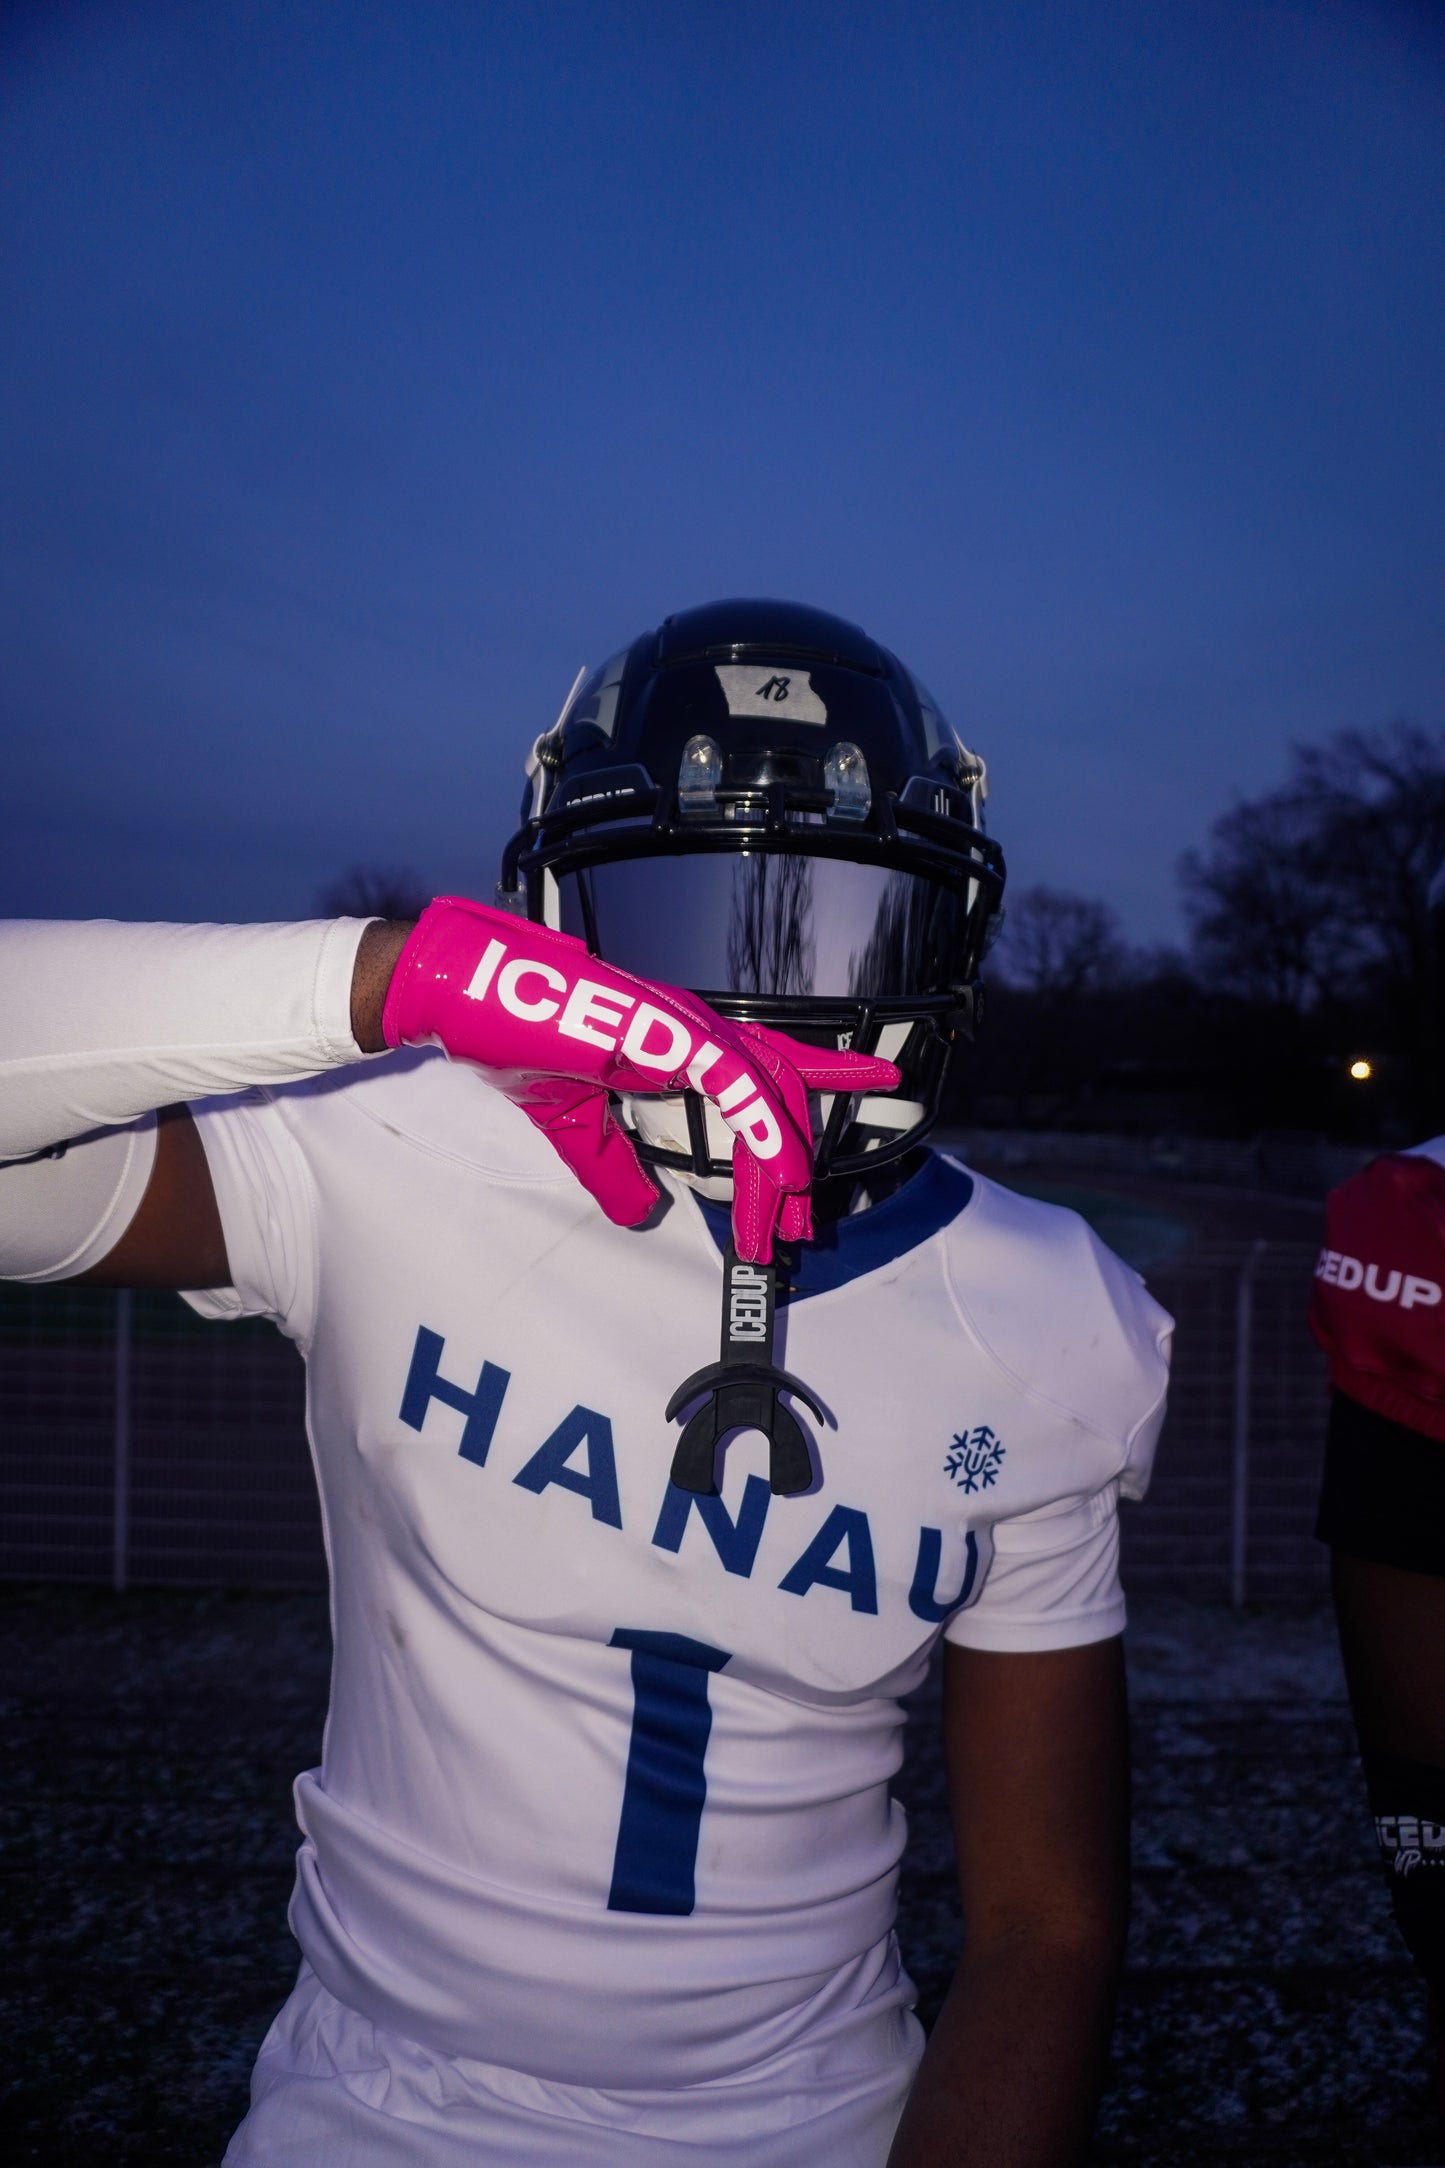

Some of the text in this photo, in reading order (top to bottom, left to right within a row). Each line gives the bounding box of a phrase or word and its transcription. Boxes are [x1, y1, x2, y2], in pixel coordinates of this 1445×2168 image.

[755, 675, 791, 702] 18
[463, 938, 783, 1160] ICEDUP
[729, 1265, 768, 1342] ICEDUP
[399, 1324, 978, 1623] HANAU
